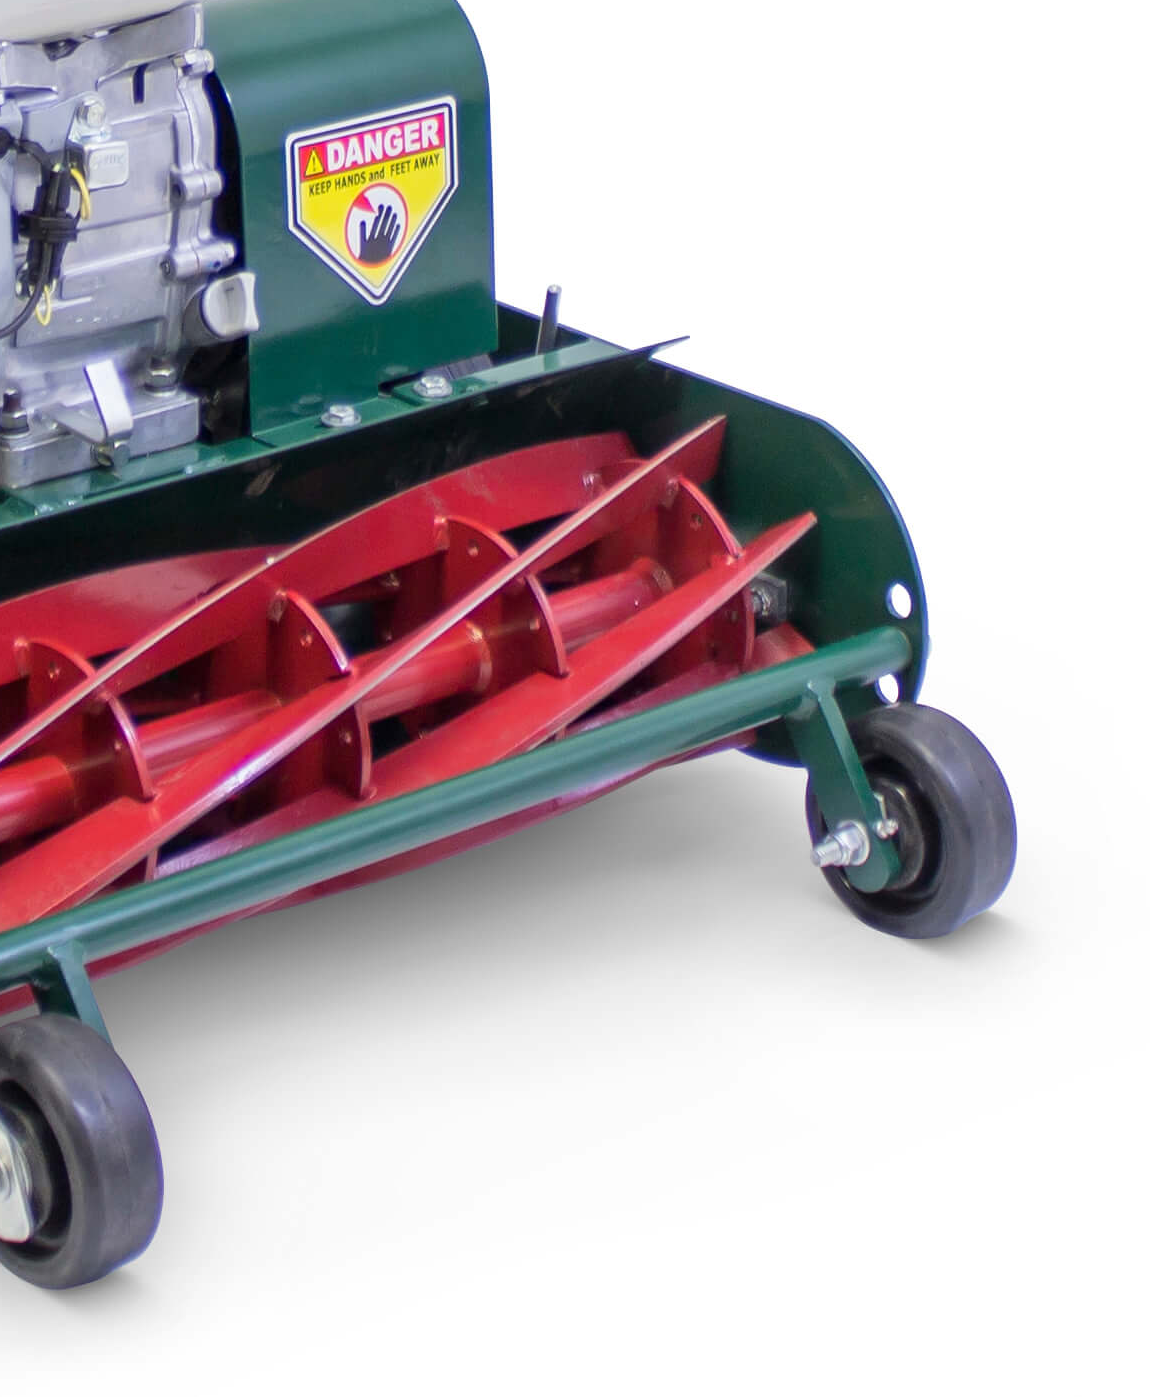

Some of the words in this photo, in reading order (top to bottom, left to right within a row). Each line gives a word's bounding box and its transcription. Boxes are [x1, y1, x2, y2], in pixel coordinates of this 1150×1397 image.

[325, 118, 440, 173] DANGER
[308, 181, 332, 198] KEEP
[334, 171, 367, 191] HANDS
[368, 166, 385, 182] and
[390, 160, 411, 178] FEET
[413, 153, 441, 172] AWAY
